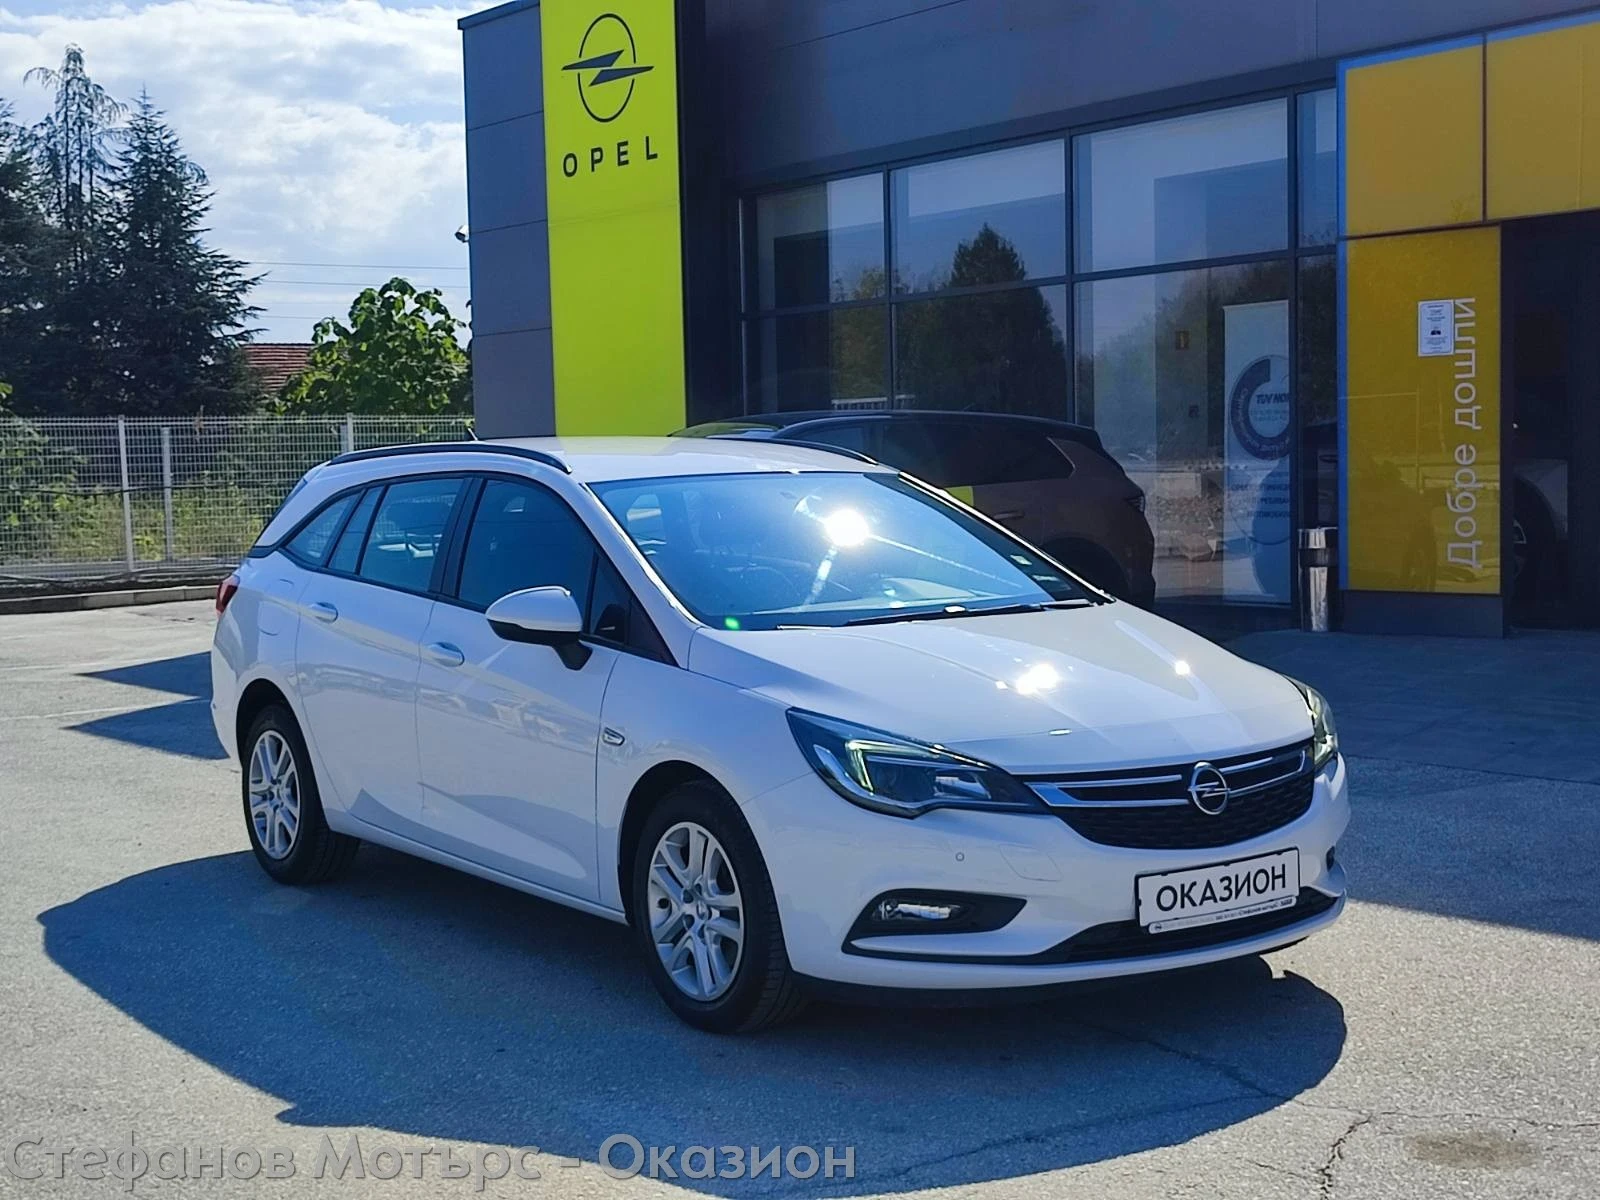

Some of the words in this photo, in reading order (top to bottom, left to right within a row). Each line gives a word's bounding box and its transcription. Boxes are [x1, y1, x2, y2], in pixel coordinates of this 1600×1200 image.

[562, 135, 658, 178] OPEL
[1454, 297, 1482, 430] дошли
[1447, 443, 1484, 569] Добре
[1156, 863, 1286, 912] ОКАЗИОН
